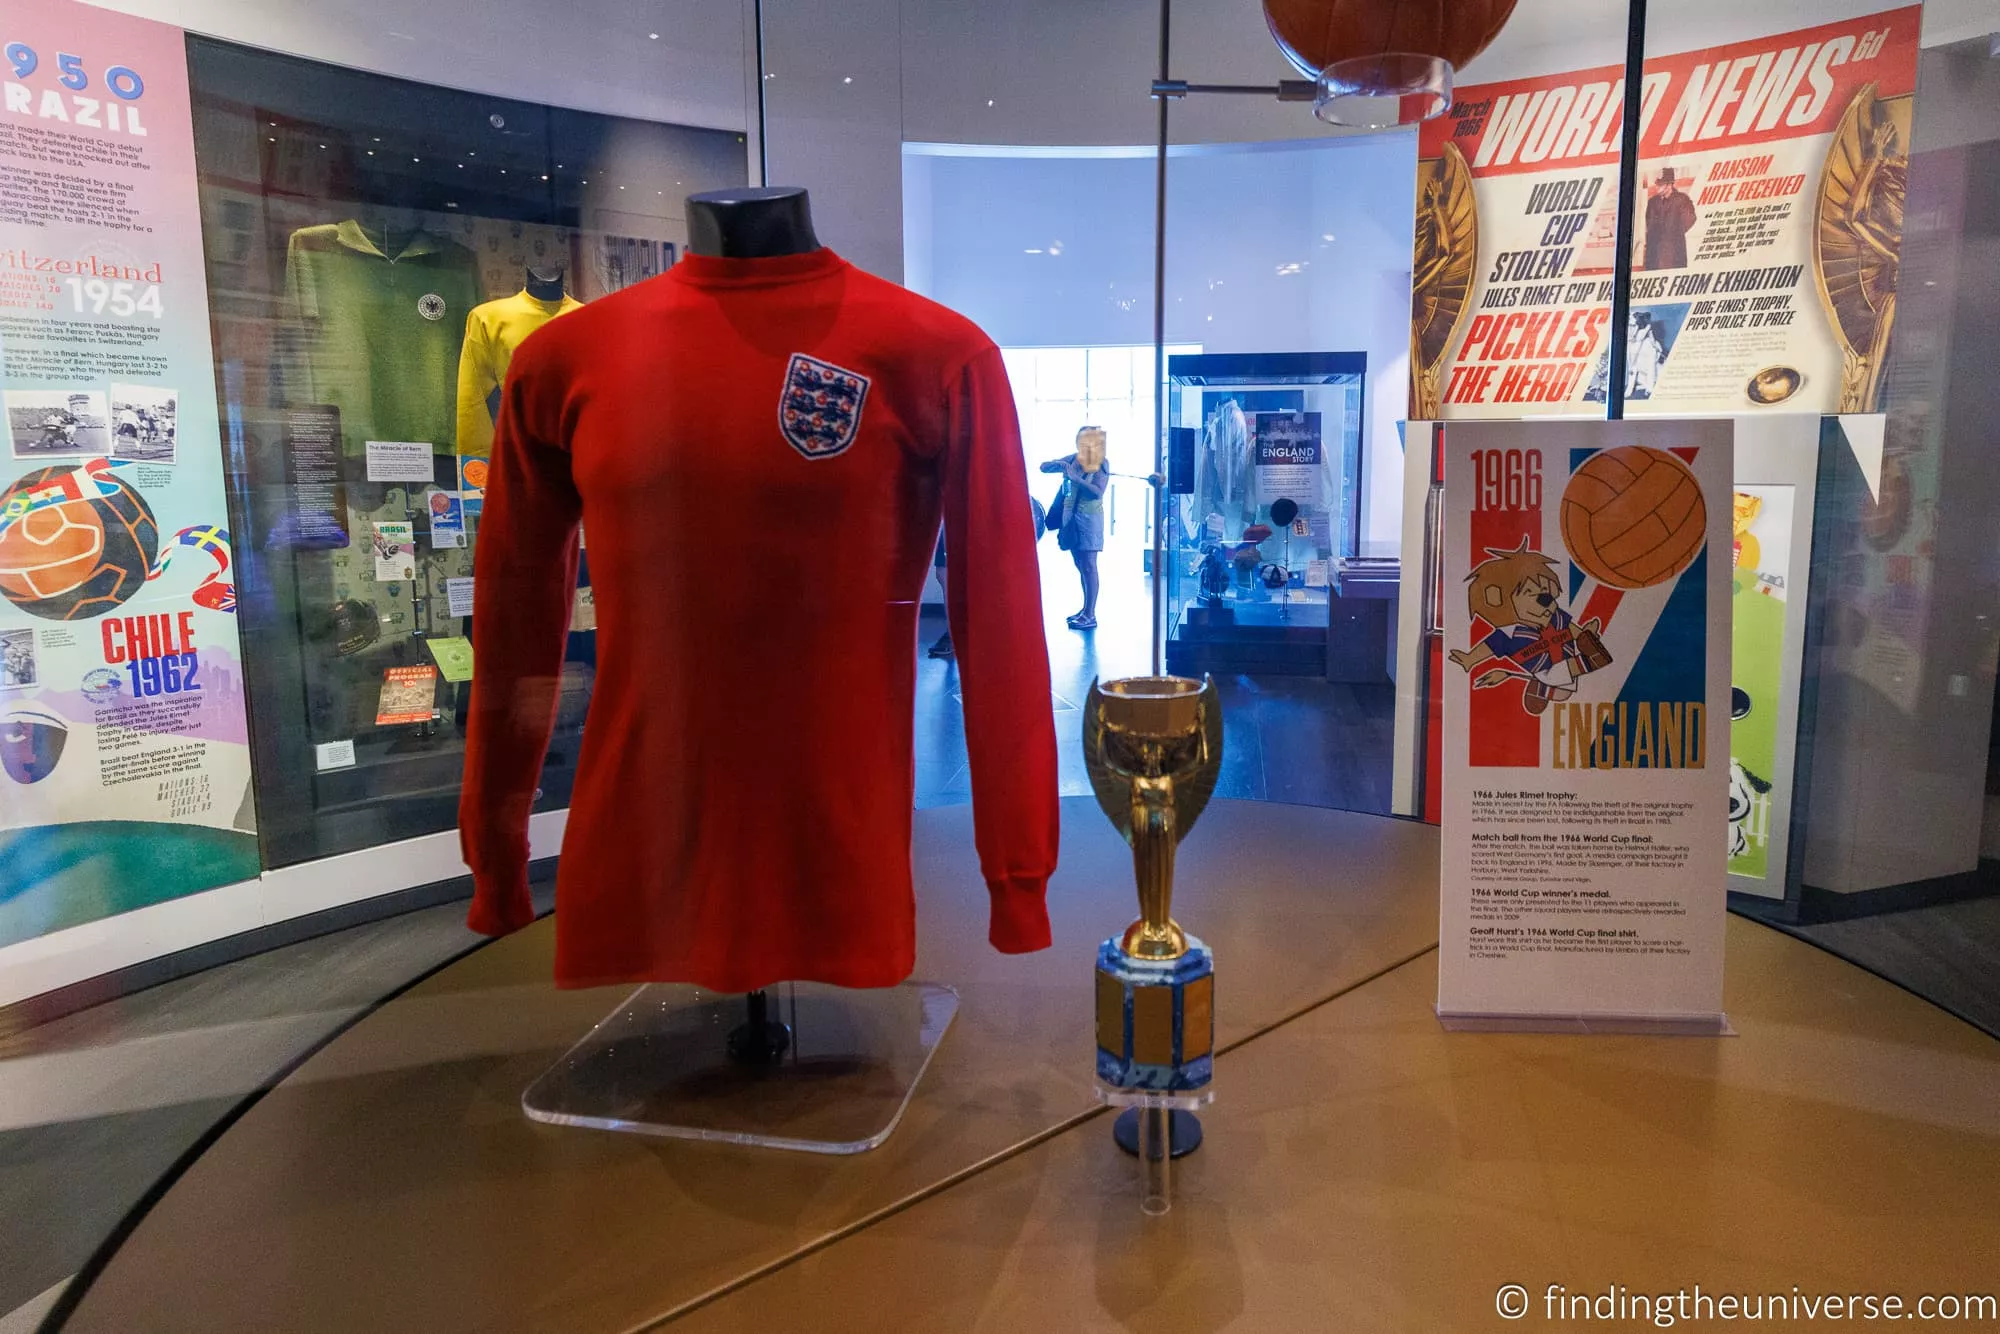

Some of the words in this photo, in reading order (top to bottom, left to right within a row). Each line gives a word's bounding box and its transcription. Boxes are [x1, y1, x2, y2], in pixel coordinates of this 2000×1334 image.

[1852, 28, 1890, 62] 6d
[1659, 35, 1856, 146] NEWS
[1450, 97, 1492, 119] March
[18, 126, 45, 136] made
[48, 130, 66, 140] their
[69, 134, 95, 145] World
[96, 139, 115, 150] Cup
[117, 143, 143, 153] debut
[1452, 118, 1484, 138] 1966
[18, 133, 39, 145] They
[42, 137, 83, 151] defeated
[84, 145, 108, 156] Chile
[120, 151, 139, 161] their
[32, 144, 47, 153] but
[50, 149, 72, 157] were
[73, 151, 113, 165] knocked
[115, 158, 129, 167] out
[131, 162, 151, 171] after
[1707, 154, 1774, 182] RANSOM
[1525, 177, 1604, 215] WORLD
[1697, 183, 1737, 206] NOTE
[1735, 174, 1806, 202] RECEIVED
[1540, 212, 1589, 246] CUP
[0, 250, 164, 284] itzerland
[1489, 247, 1575, 283] STOLEN!
[65, 277, 164, 319] 1954
[1480, 287, 1520, 309] JULES
[1520, 284, 1565, 306] RIMET
[1564, 282, 1596, 304] CUP
[1667, 272, 1713, 297] FROM
[1712, 265, 1804, 294] EXHIBITION
[1692, 300, 1716, 315] DOG
[1715, 298, 1748, 314] FINDS
[50, 318, 67, 327] four
[69, 321, 92, 331] years
[94, 322, 110, 330] and
[111, 323, 145, 334] boasting
[147, 325, 161, 333] star
[1685, 316, 1712, 331] PIPS
[1711, 314, 1748, 330] POLICE
[1748, 313, 1763, 328] TO
[1763, 310, 1797, 327] PRIZE
[1456, 307, 1611, 362] PICKLES
[1442, 365, 1499, 404] THE
[1493, 362, 1587, 404] HERO!
[1263, 448, 1314, 457] ENGLAND
[1470, 449, 1542, 511] 1966
[380, 526, 406, 534] BRASIL
[101, 611, 197, 664] CHILE
[1521, 640, 1549, 658] WORLD
[1552, 632, 1568, 644] CUP
[126, 653, 201, 698] 1962
[95, 706, 133, 716] Garrincha
[164, 696, 202, 706] inspiration
[139, 709, 155, 717] they
[158, 703, 201, 713] successfully
[96, 720, 134, 730] defended
[149, 714, 168, 722] Jules
[170, 710, 190, 718] Rimet
[97, 729, 121, 737] Trophy
[156, 719, 183, 728] despite
[98, 736, 120, 744] losing
[149, 728, 169, 736] injury
[189, 722, 202, 731] just
[1552, 702, 1706, 769] ENGLAND
[100, 757, 120, 765] Brazil
[141, 748, 170, 758] England
[102, 760, 150, 773] quarter-finals
[152, 755, 176, 763] before
[177, 750, 206, 758] winning
[172, 757, 199, 767] against
[102, 771, 162, 786] Czechoslovakia
[1473, 791, 1493, 799] 1966
[1495, 791, 1518, 799] Jules
[1546, 792, 1578, 801] trophy:
[1521, 834, 1541, 842] from
[1543, 834, 1558, 842] the
[1561, 834, 1581, 842] 1966
[1583, 835, 1608, 843] World
[1611, 835, 1630, 844] Cup
[1631, 835, 1653, 843] final:
[1492, 889, 1519, 897] World
[1521, 889, 1540, 898] Cup
[1542, 890, 1578, 898] winner's
[1580, 890, 1611, 898] medal.
[1470, 927, 1494, 936] Geoff
[1496, 928, 1524, 936] Hurst's
[1527, 928, 1547, 936] 1966
[1550, 929, 1574, 937] World
[1576, 929, 1596, 938] Cup
[1598, 929, 1617, 937] final
[1619, 930, 1639, 938] shirt.
